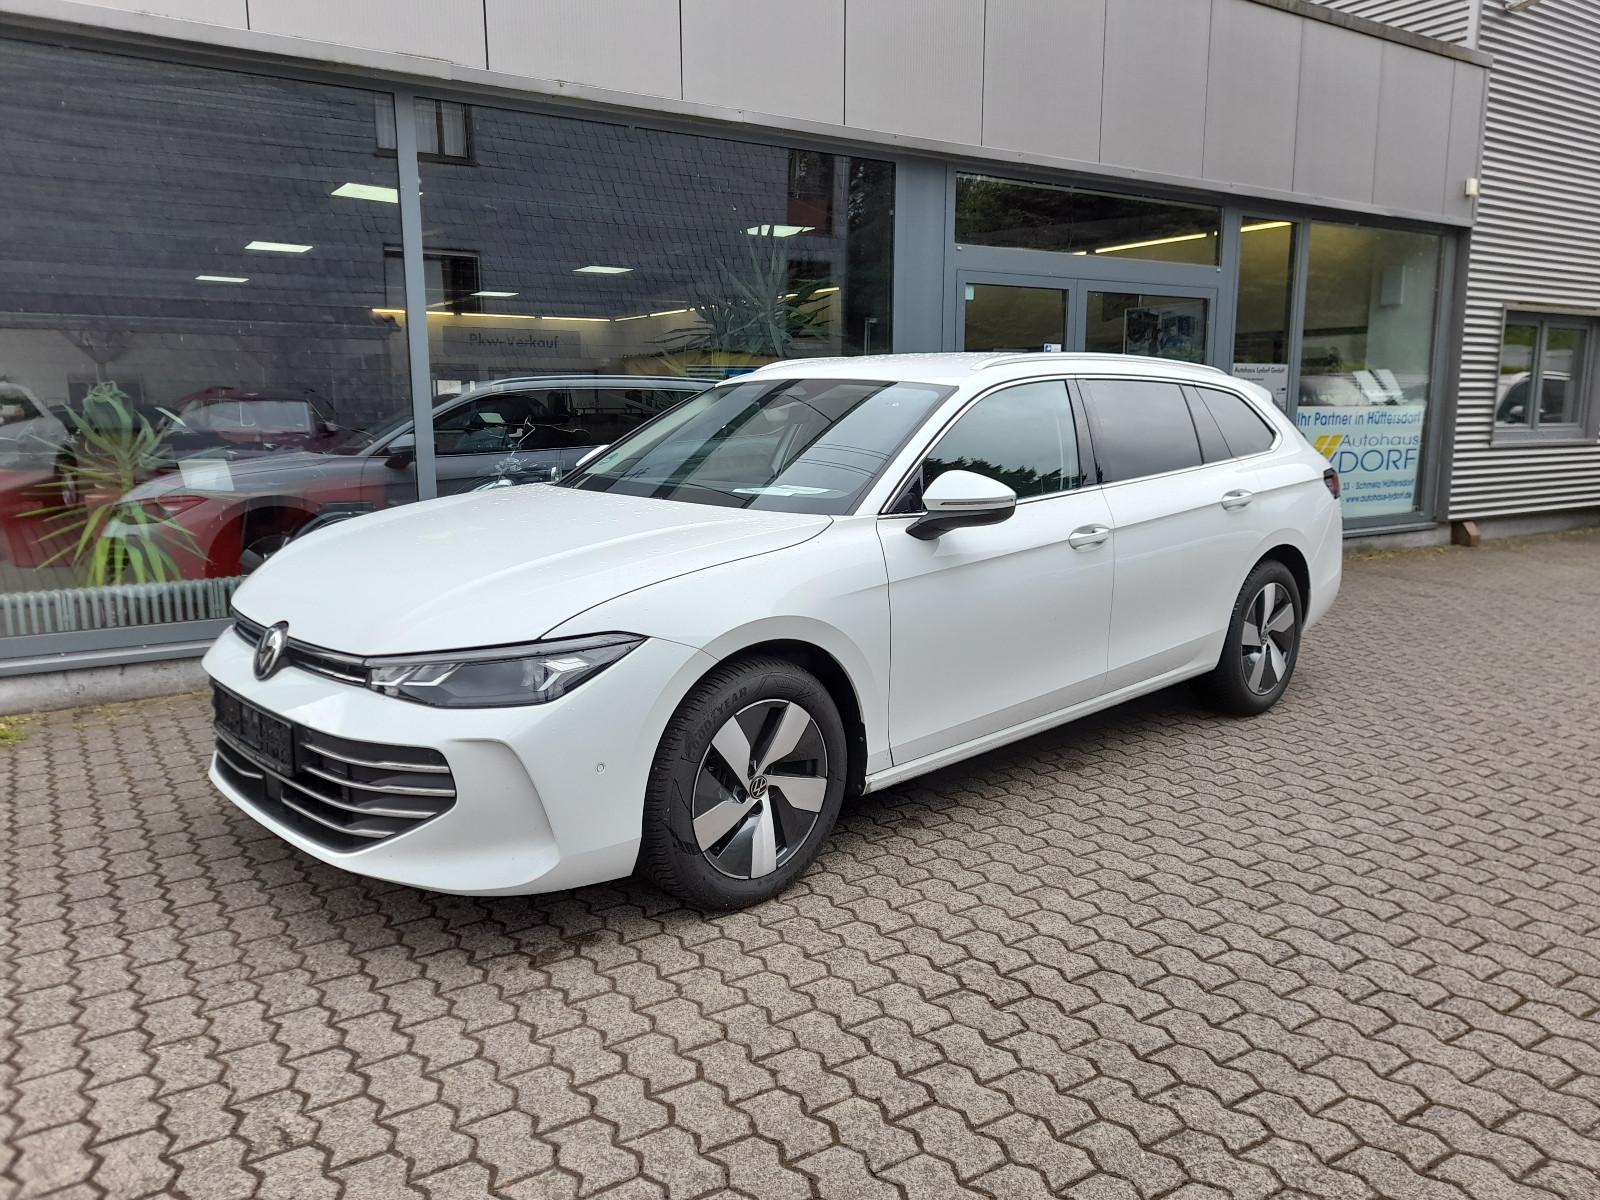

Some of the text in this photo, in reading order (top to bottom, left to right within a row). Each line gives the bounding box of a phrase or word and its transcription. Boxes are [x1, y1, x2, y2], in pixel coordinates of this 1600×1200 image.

[1297, 410, 1421, 426] Ihr Partner in Hüttersdorf
[1340, 433, 1419, 447] Autohaus
